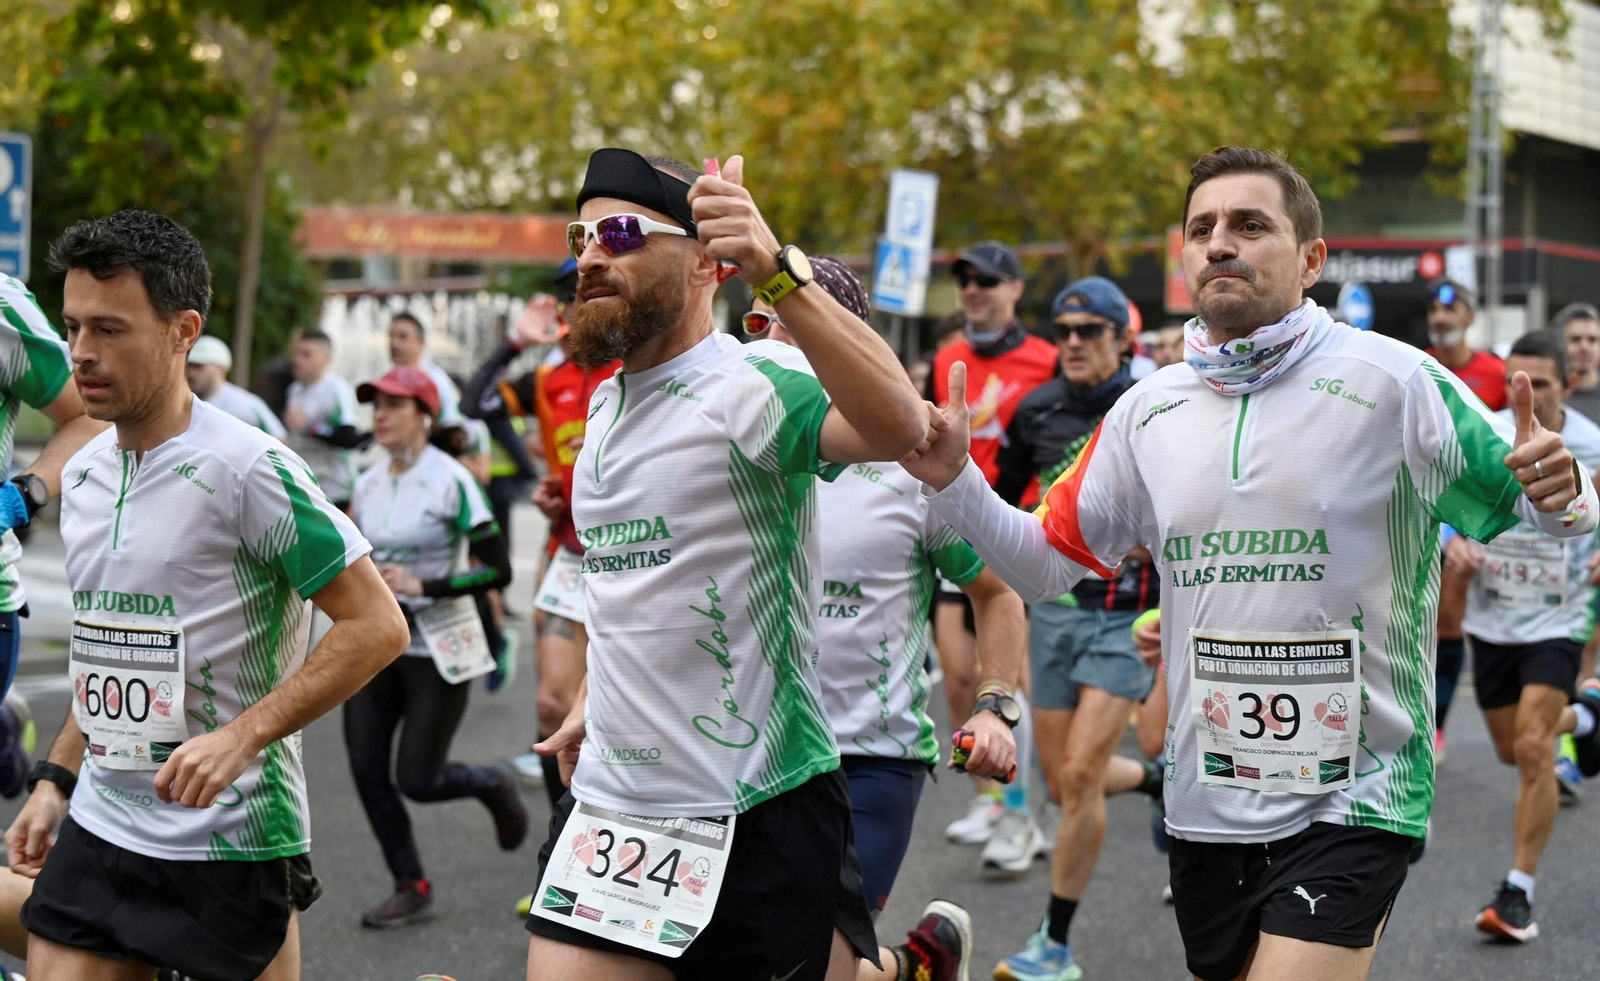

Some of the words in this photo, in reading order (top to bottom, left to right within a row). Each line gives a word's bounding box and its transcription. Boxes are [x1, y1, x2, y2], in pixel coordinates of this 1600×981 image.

[1321, 250, 1416, 285] ajasur
[1309, 378, 1344, 396] SIG
[1342, 390, 1378, 411] Laboral
[853, 463, 883, 483] SIG
[191, 477, 216, 496] Laboral
[582, 515, 674, 551] SUBIDA
[1200, 528, 1332, 559] SUBIDA
[600, 548, 672, 573] ERMITAS
[1181, 566, 1217, 588] LAS
[1219, 562, 1326, 584] ERMITAS
[94, 590, 178, 618] SUBIDA
[80, 626, 104, 642] SUBIDA
[103, 630, 111, 642] A
[110, 631, 126, 644] LAS
[126, 633, 172, 647] ERMITAS
[81, 643, 88, 655] LA
[121, 648, 132, 661] DE
[132, 649, 176, 664] ORGANOS
[1197, 641, 1211, 654] XII
[1211, 642, 1252, 658] SUBIDA
[1253, 645, 1264, 658] A
[1265, 645, 1287, 659] LAS
[1289, 643, 1345, 659] ERMITAS
[1198, 658, 1215, 672] POR
[1216, 660, 1228, 674] LA
[1228, 661, 1280, 676] DONACIÓN
[1281, 663, 1296, 676] DE
[1297, 661, 1350, 676] ORGANOS
[85, 672, 151, 723] 600
[1237, 691, 1301, 741] 39
[1328, 715, 1347, 723] TALLA
[1232, 746, 1262, 755] FRANCISCO
[1262, 748, 1296, 756] DOMINGUEZ
[674, 817, 725, 841] ORGANOS
[585, 828, 683, 898] 324
[688, 877, 707, 889] TALLA
[627, 895, 662, 912] RODRIGUEZ
